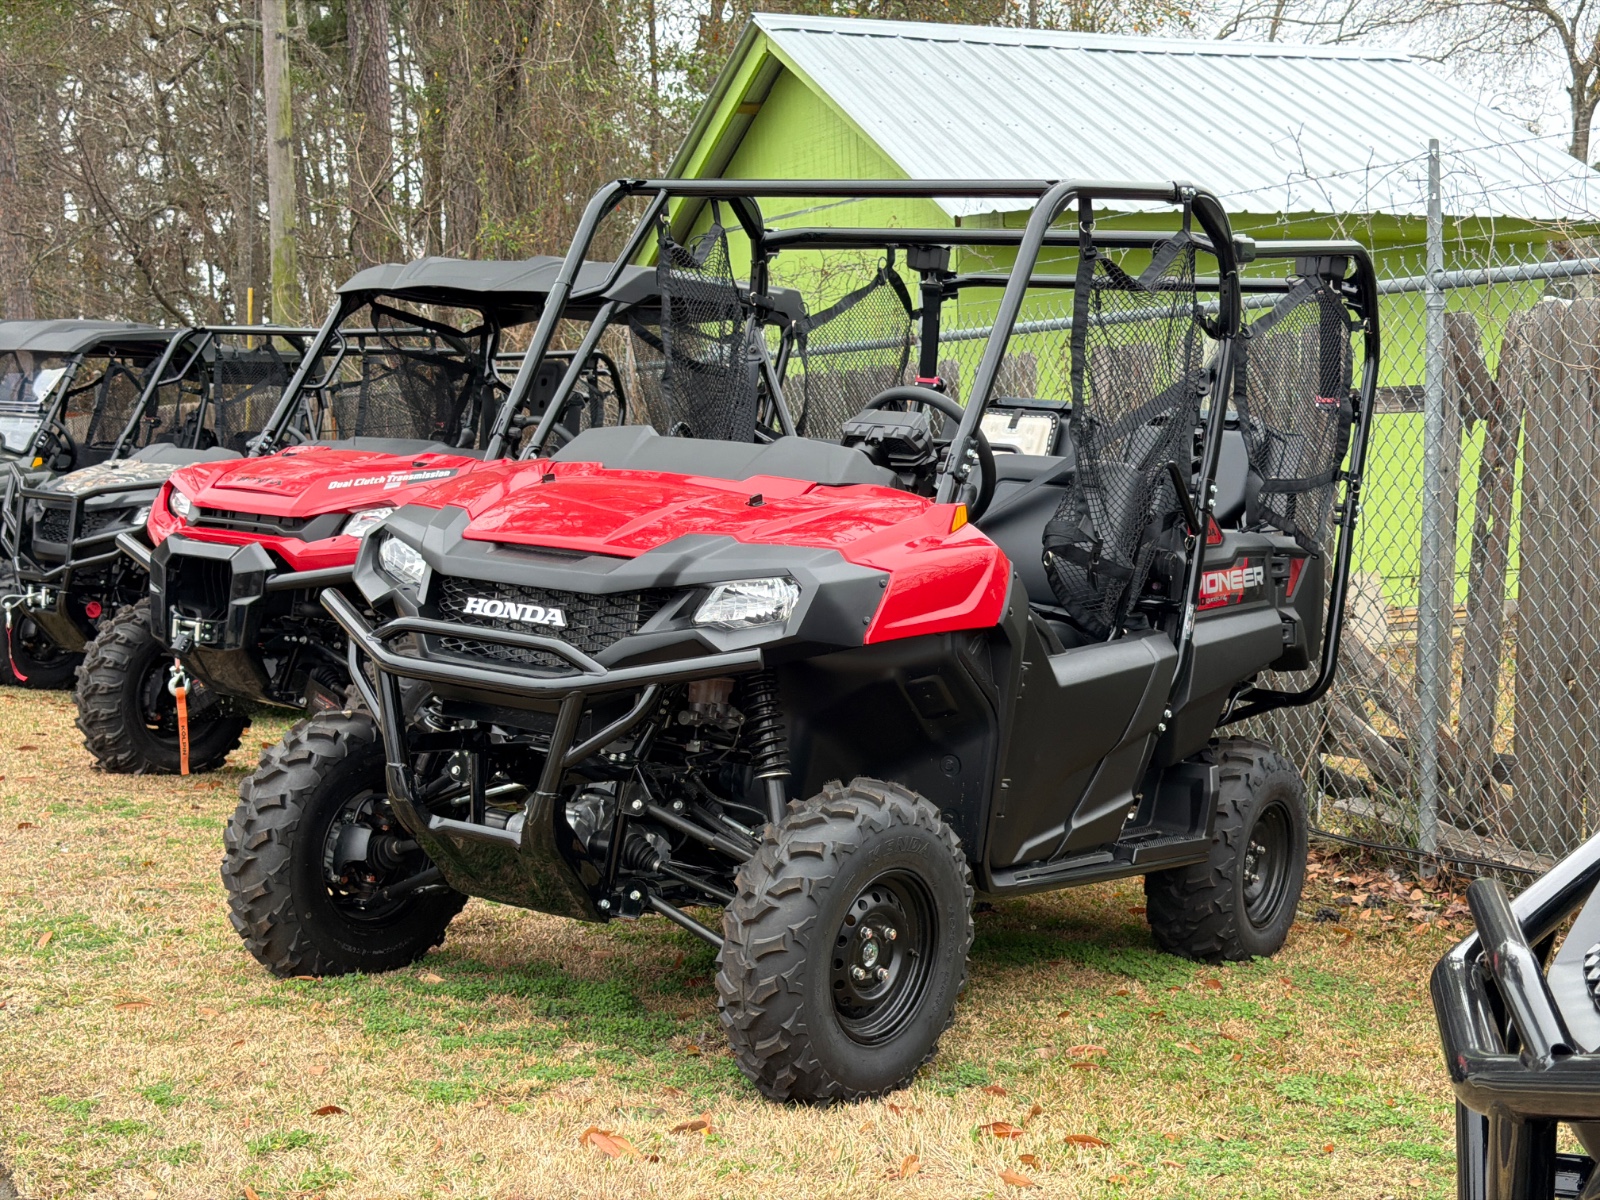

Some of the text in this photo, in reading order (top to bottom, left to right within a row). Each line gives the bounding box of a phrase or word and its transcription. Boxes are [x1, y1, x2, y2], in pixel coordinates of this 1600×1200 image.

[328, 470, 451, 490] Dual Clutch Transmission
[463, 597, 567, 627] HONDA
[867, 835, 931, 866] KENDA
